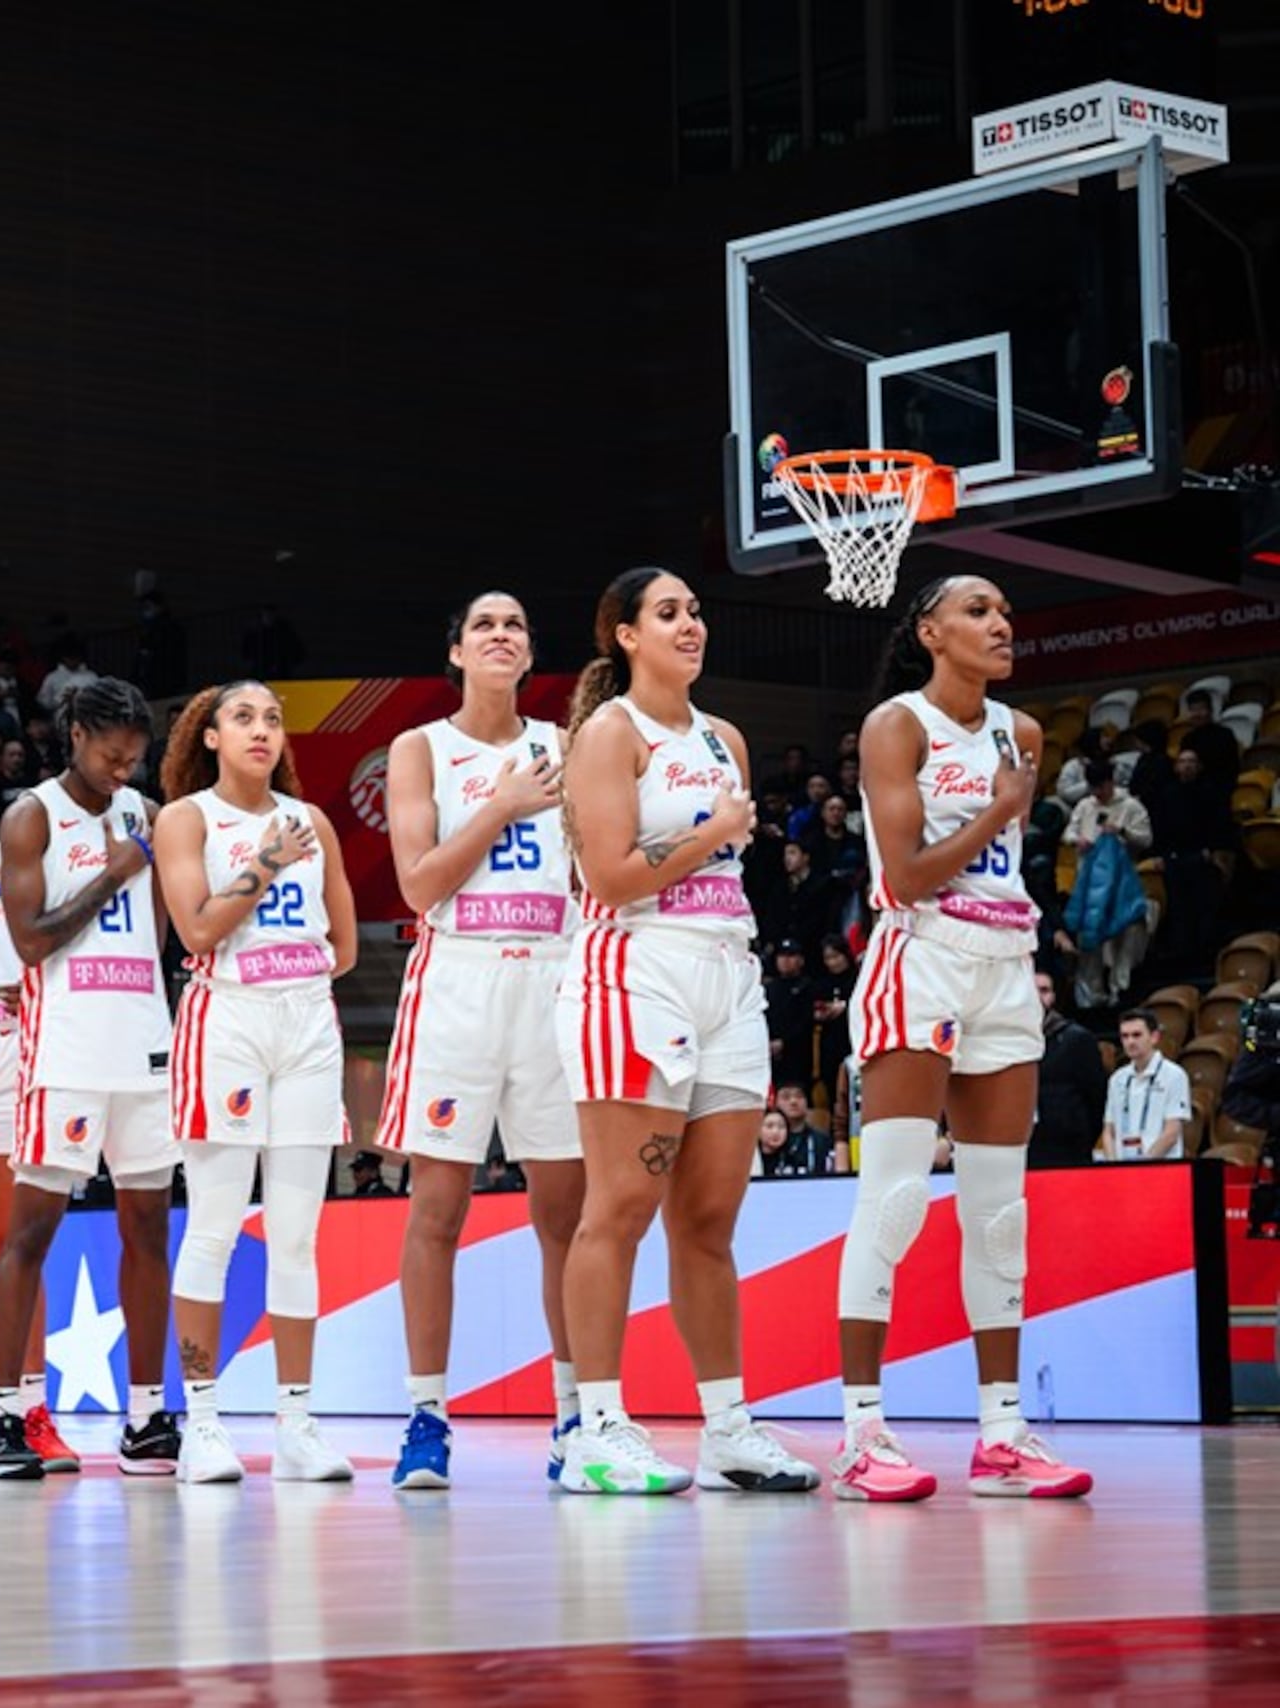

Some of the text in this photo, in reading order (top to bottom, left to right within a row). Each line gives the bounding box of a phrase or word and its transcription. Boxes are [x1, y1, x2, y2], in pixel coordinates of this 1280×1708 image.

[1016, 97, 1102, 138] TISSOT
[1147, 102, 1219, 136] TISSOT
[1040, 624, 1129, 654] WOMEN'S
[1133, 611, 1218, 640] OLYMPIC
[490, 822, 541, 871] 25
[99, 889, 133, 932] 21
[256, 881, 305, 927] 22
[488, 900, 558, 926] Mobile
